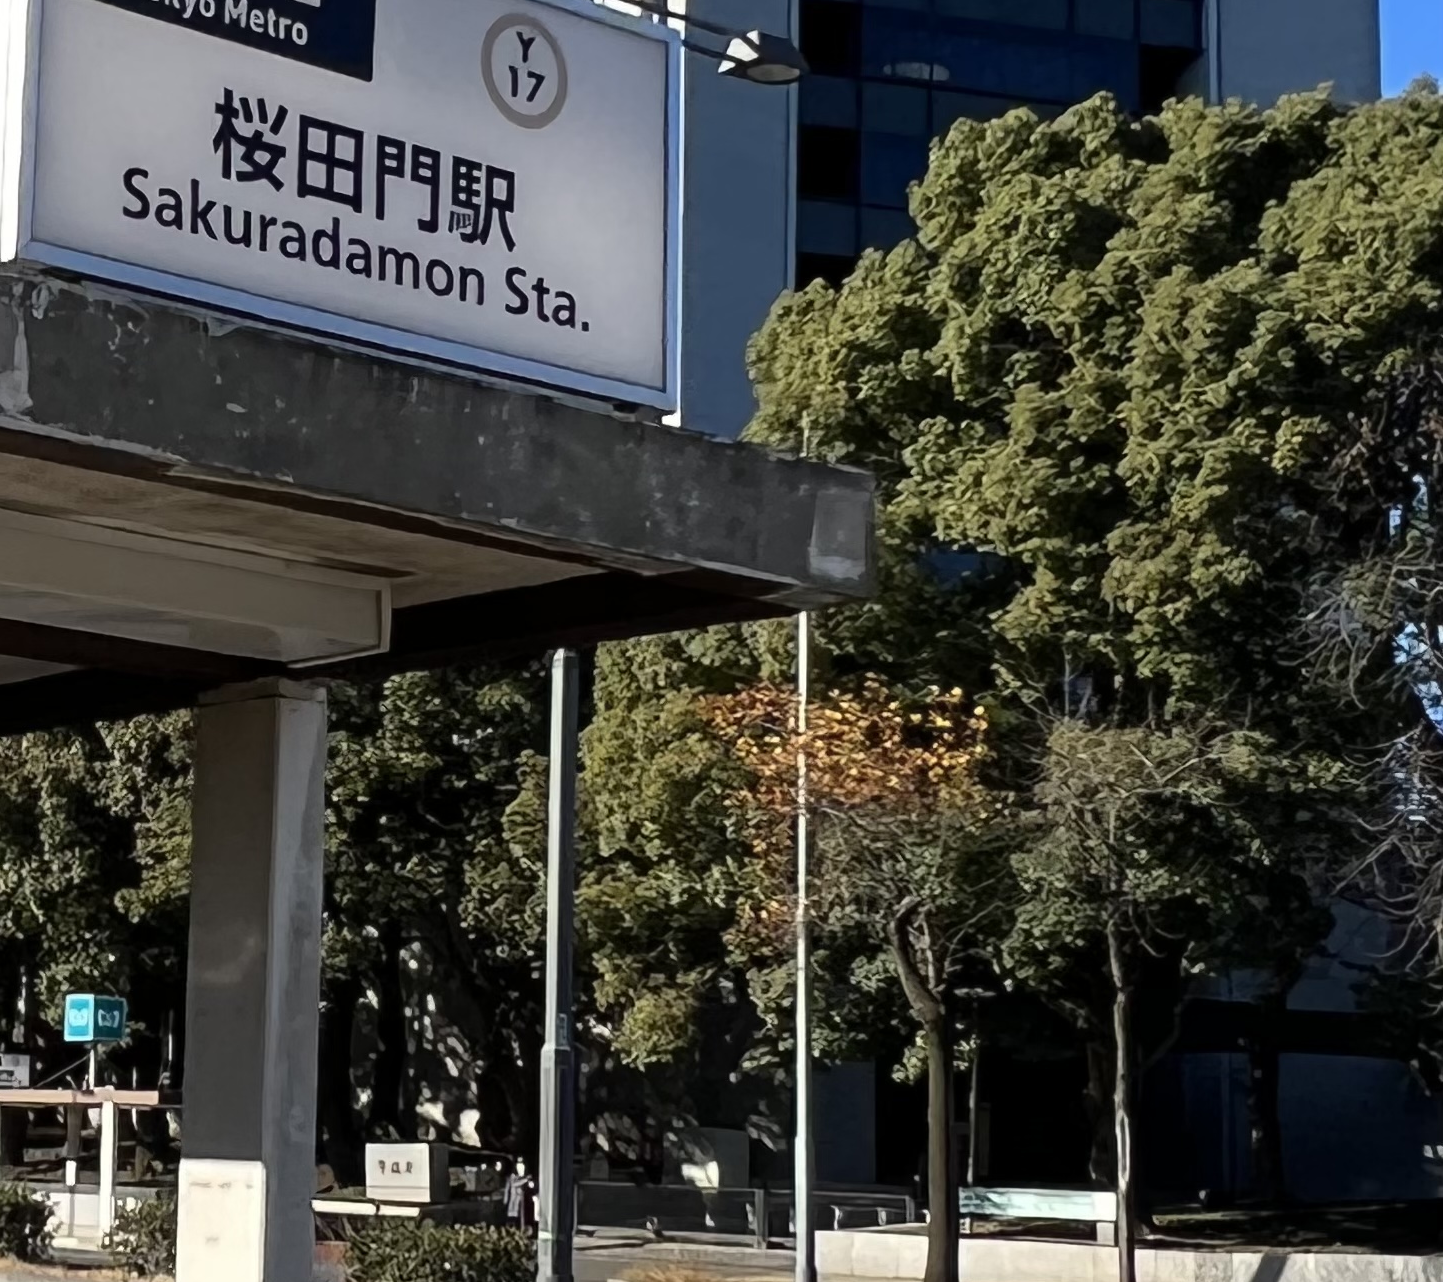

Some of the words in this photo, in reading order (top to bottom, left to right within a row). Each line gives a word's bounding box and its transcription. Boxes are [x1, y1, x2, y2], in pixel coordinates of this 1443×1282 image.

[508, 65, 547, 103] 17
[515, 31, 536, 64] Y
[212, 86, 517, 253] 桜田門駅
[121, 166, 487, 306] Sakuradamon
[504, 266, 592, 333] Sta.
